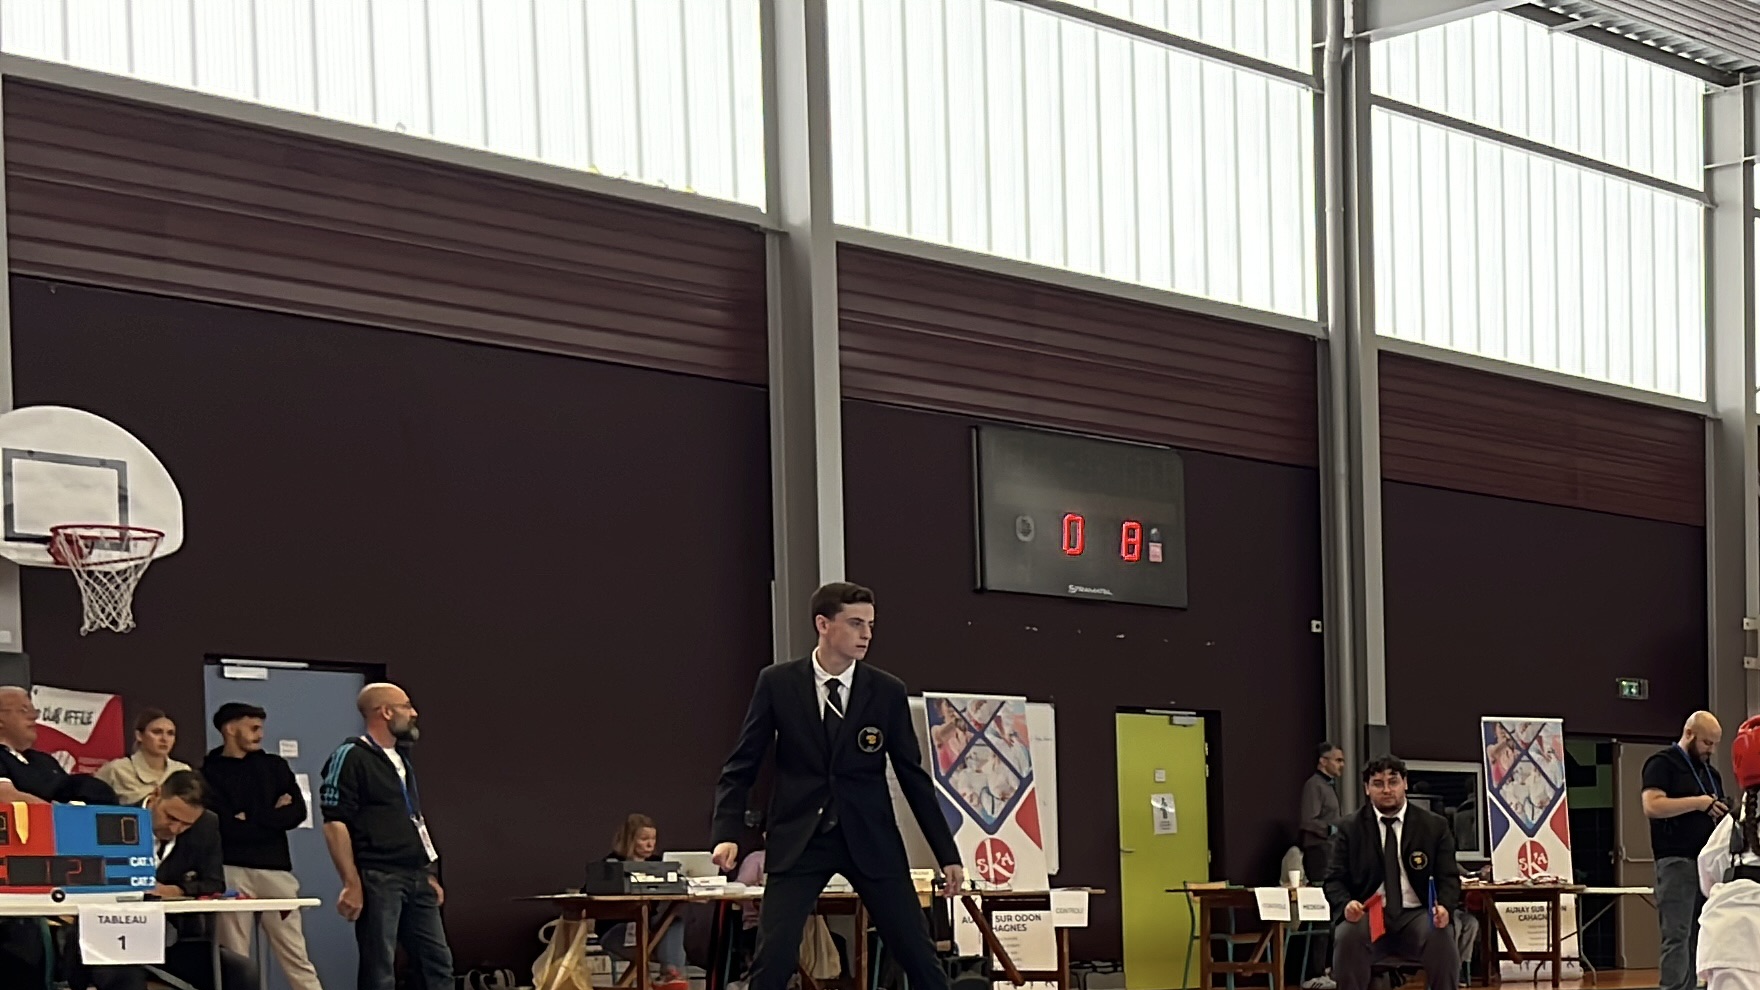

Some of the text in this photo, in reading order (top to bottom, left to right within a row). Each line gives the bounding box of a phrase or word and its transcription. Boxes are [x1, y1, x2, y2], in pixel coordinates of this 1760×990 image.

[1061, 513, 1085, 556] 0
[1121, 521, 1143, 562] 8
[975, 838, 1015, 882] SKA
[98, 915, 148, 924] TABLEAU
[995, 913, 1042, 923] SUR ODON
[117, 935, 127, 951] 1
